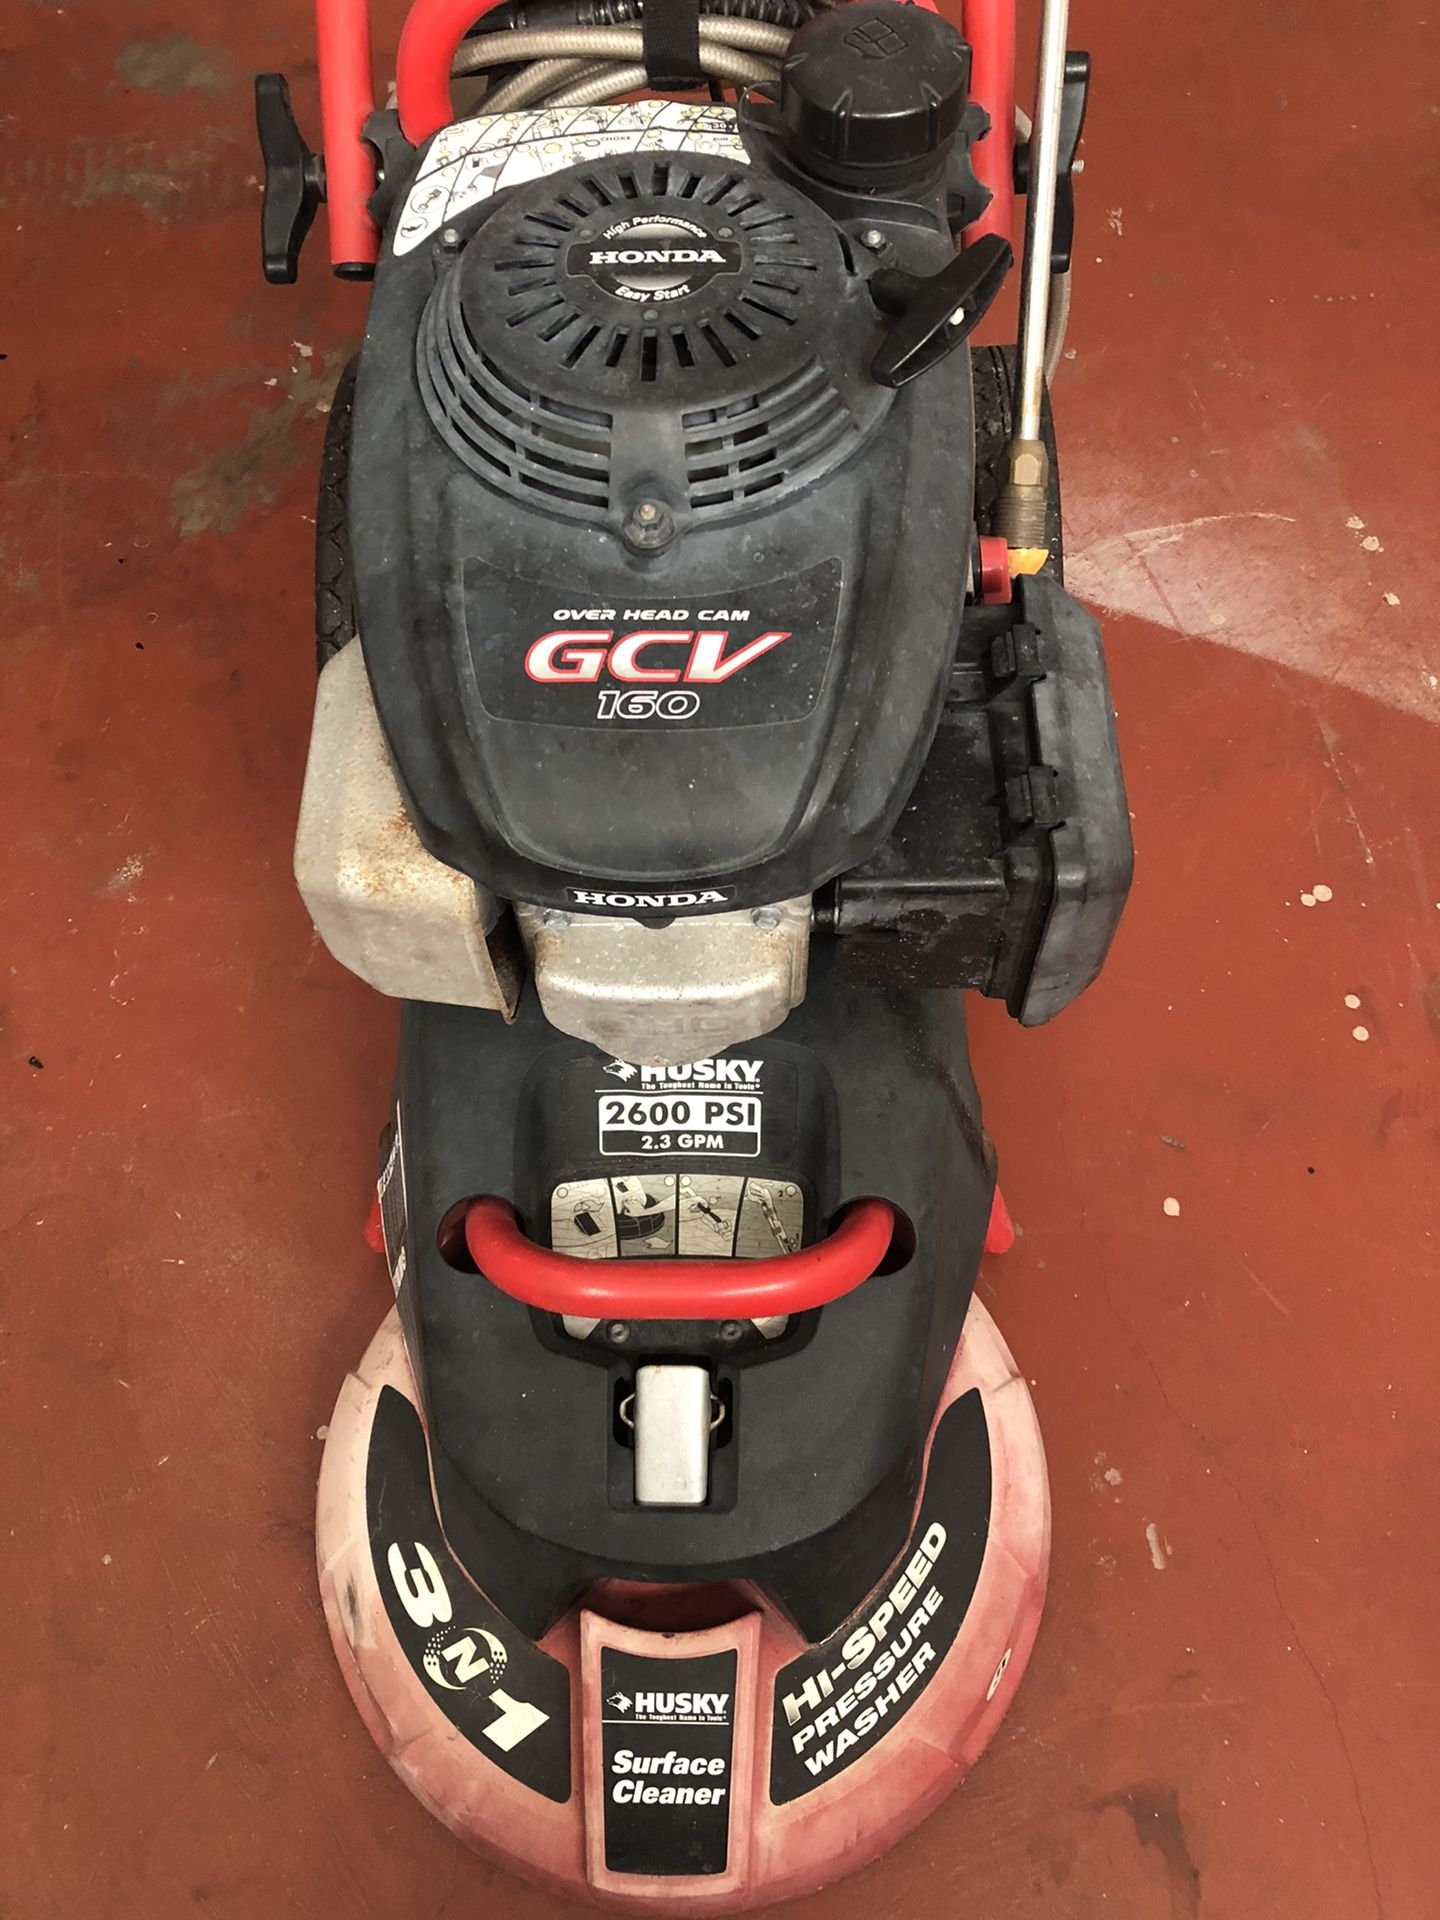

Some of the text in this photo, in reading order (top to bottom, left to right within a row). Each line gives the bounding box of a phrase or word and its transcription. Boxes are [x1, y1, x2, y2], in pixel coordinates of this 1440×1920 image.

[603, 215, 707, 240] High Performance
[589, 250, 726, 264] HONDA
[615, 284, 690, 303] Easy Start
[553, 609, 750, 621] OVER HEAD CAM
[524, 630, 792, 683] GCV
[597, 690, 700, 719] 160
[573, 891, 728, 907] HONDA
[641, 1059, 764, 1082] HUSKY
[606, 1101, 755, 1126] 2600 PSI
[641, 1134, 724, 1149] 2.3 GPM
[782, 1522, 947, 1726] HI-SPEED
[387, 1542, 453, 1628] 3
[481, 1688, 550, 1752] 1
[792, 1585, 944, 1754] PRESSURE
[635, 1692, 729, 1714] HUSKY
[804, 1642, 936, 1776] WASHER
[611, 1749, 725, 1775] Surface
[612, 1779, 726, 1805] Cleaner
